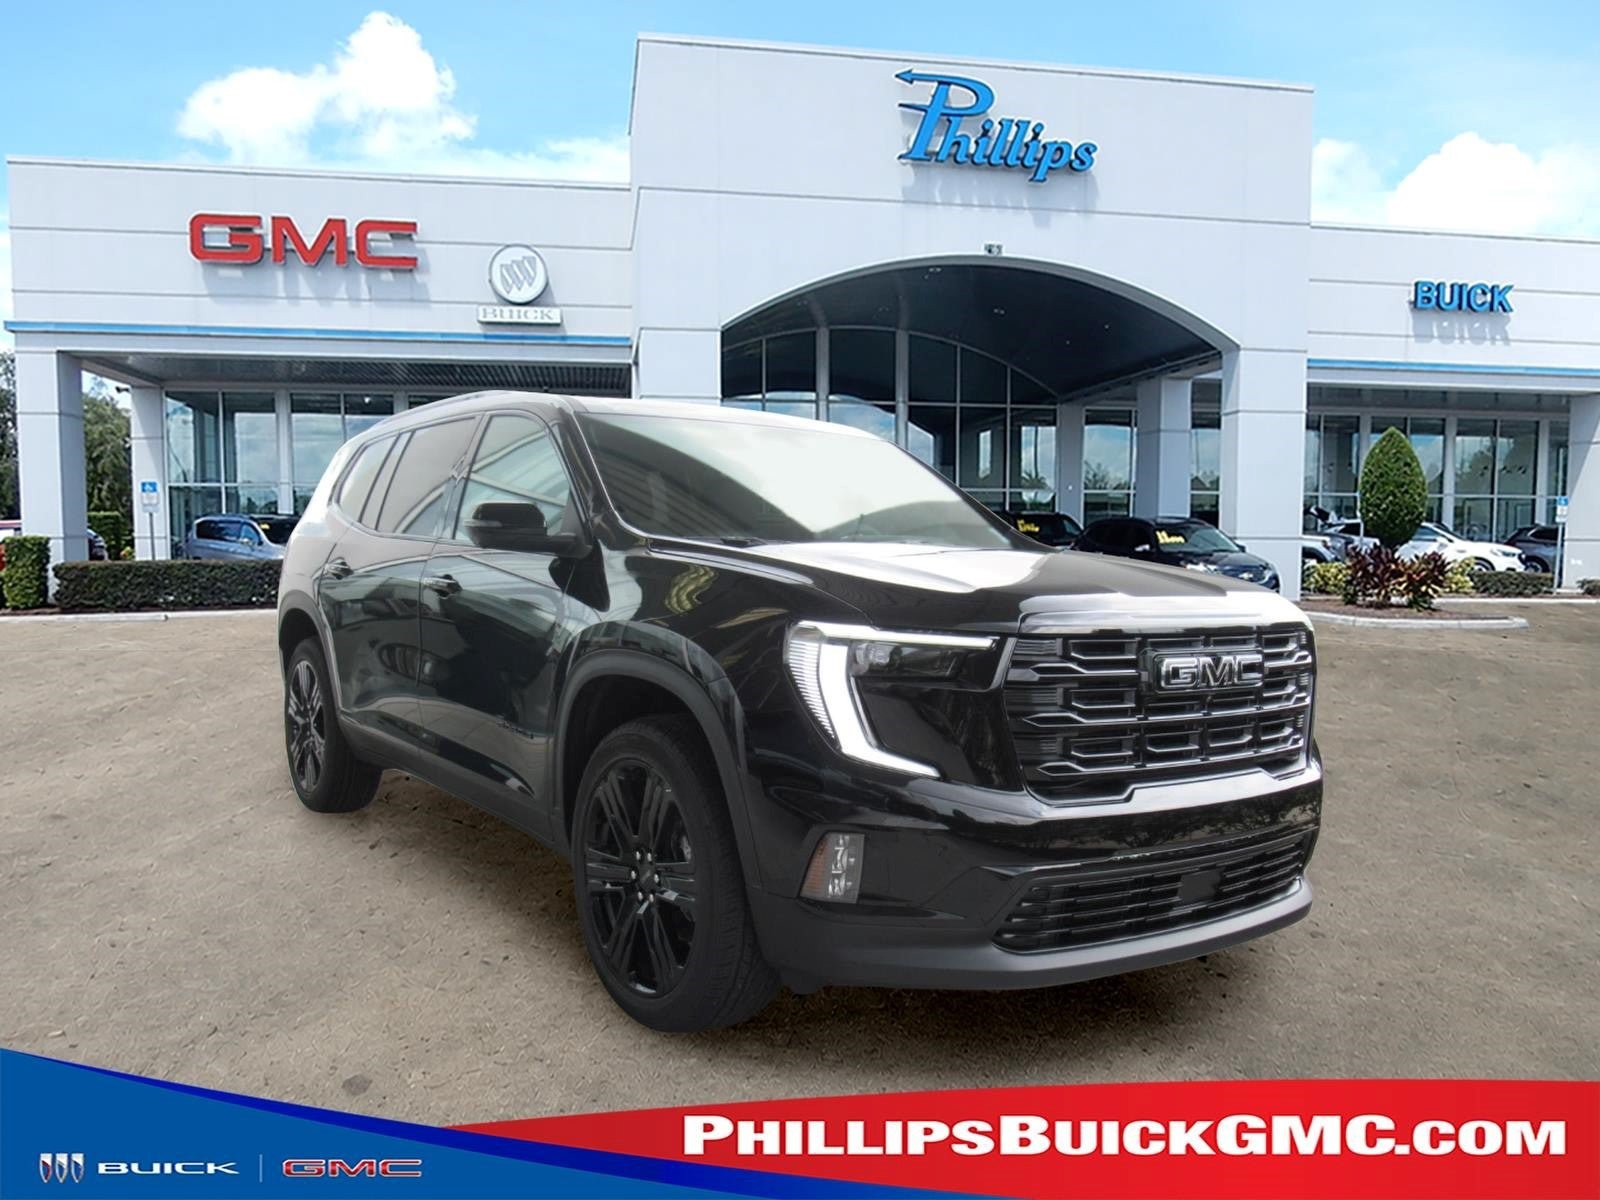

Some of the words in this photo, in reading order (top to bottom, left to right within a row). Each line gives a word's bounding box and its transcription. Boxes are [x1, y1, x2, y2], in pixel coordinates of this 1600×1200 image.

[895, 69, 1097, 182] Phillips
[189, 213, 418, 269] GMC
[1414, 280, 1513, 312] BUICK
[482, 308, 553, 320] BUICK
[1161, 654, 1263, 688] GMC
